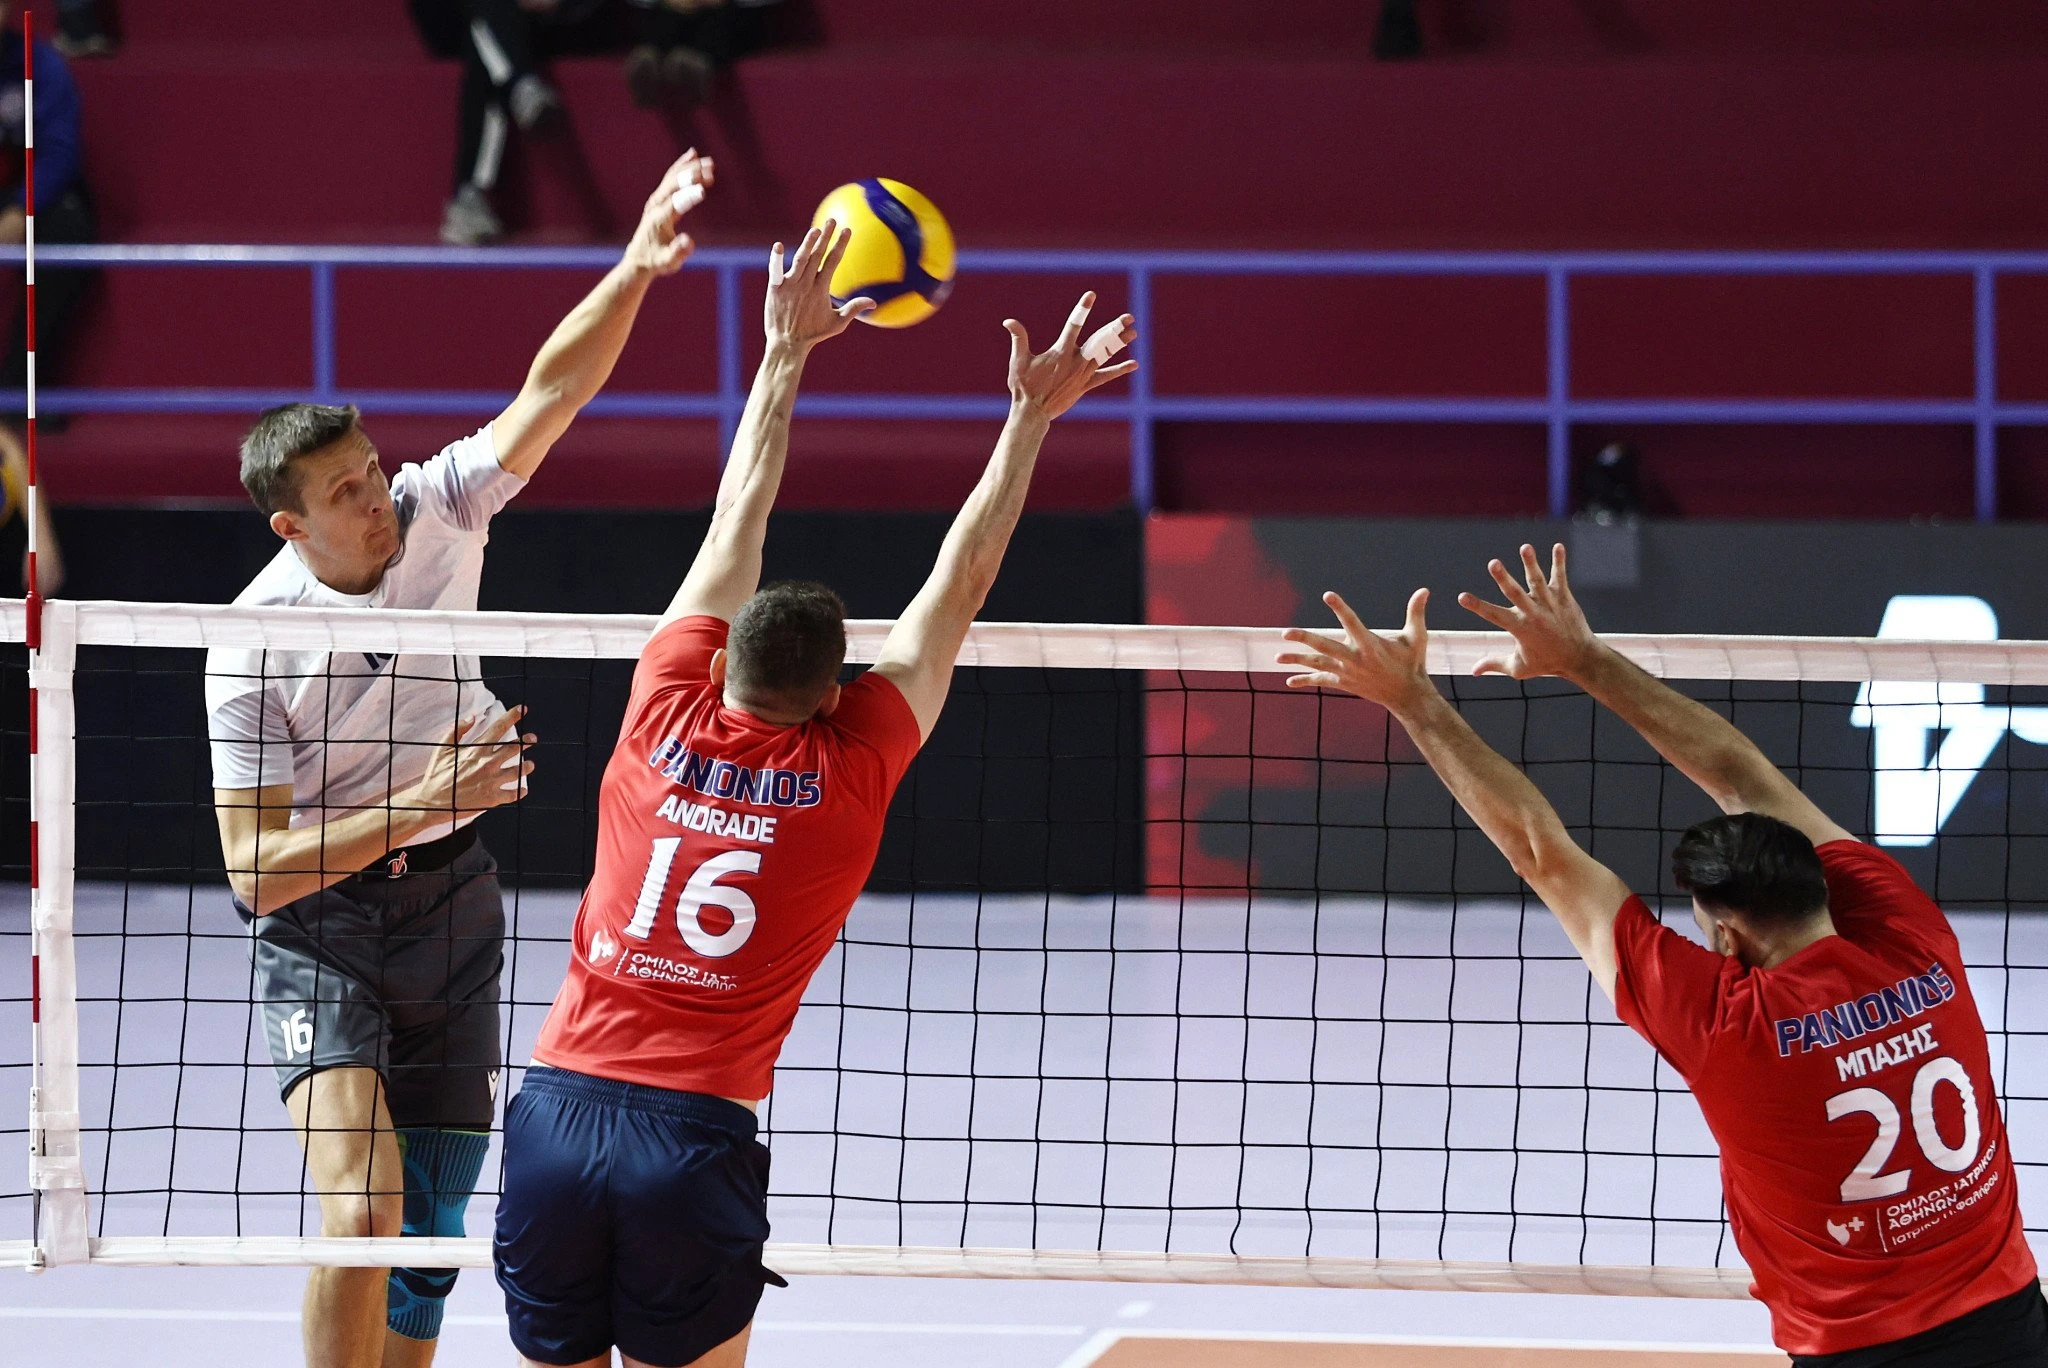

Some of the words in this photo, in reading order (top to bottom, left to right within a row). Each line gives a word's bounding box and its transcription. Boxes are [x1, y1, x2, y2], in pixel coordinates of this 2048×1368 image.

[656, 794, 777, 844] ANDRADE
[623, 836, 763, 958] 16
[631, 953, 699, 979] ΟΜΙΛΟΣ
[280, 1008, 316, 1061] 16
[1775, 961, 1956, 1057] PANIONIOS
[1835, 1022, 1939, 1082] ΜΠΑΣΗΣ
[1825, 1056, 1981, 1202] 20
[1886, 1186, 1950, 1217] ΟΜΙΛΟΣ
[1888, 1194, 1957, 1230] ΑΘΗΝΩΝ
